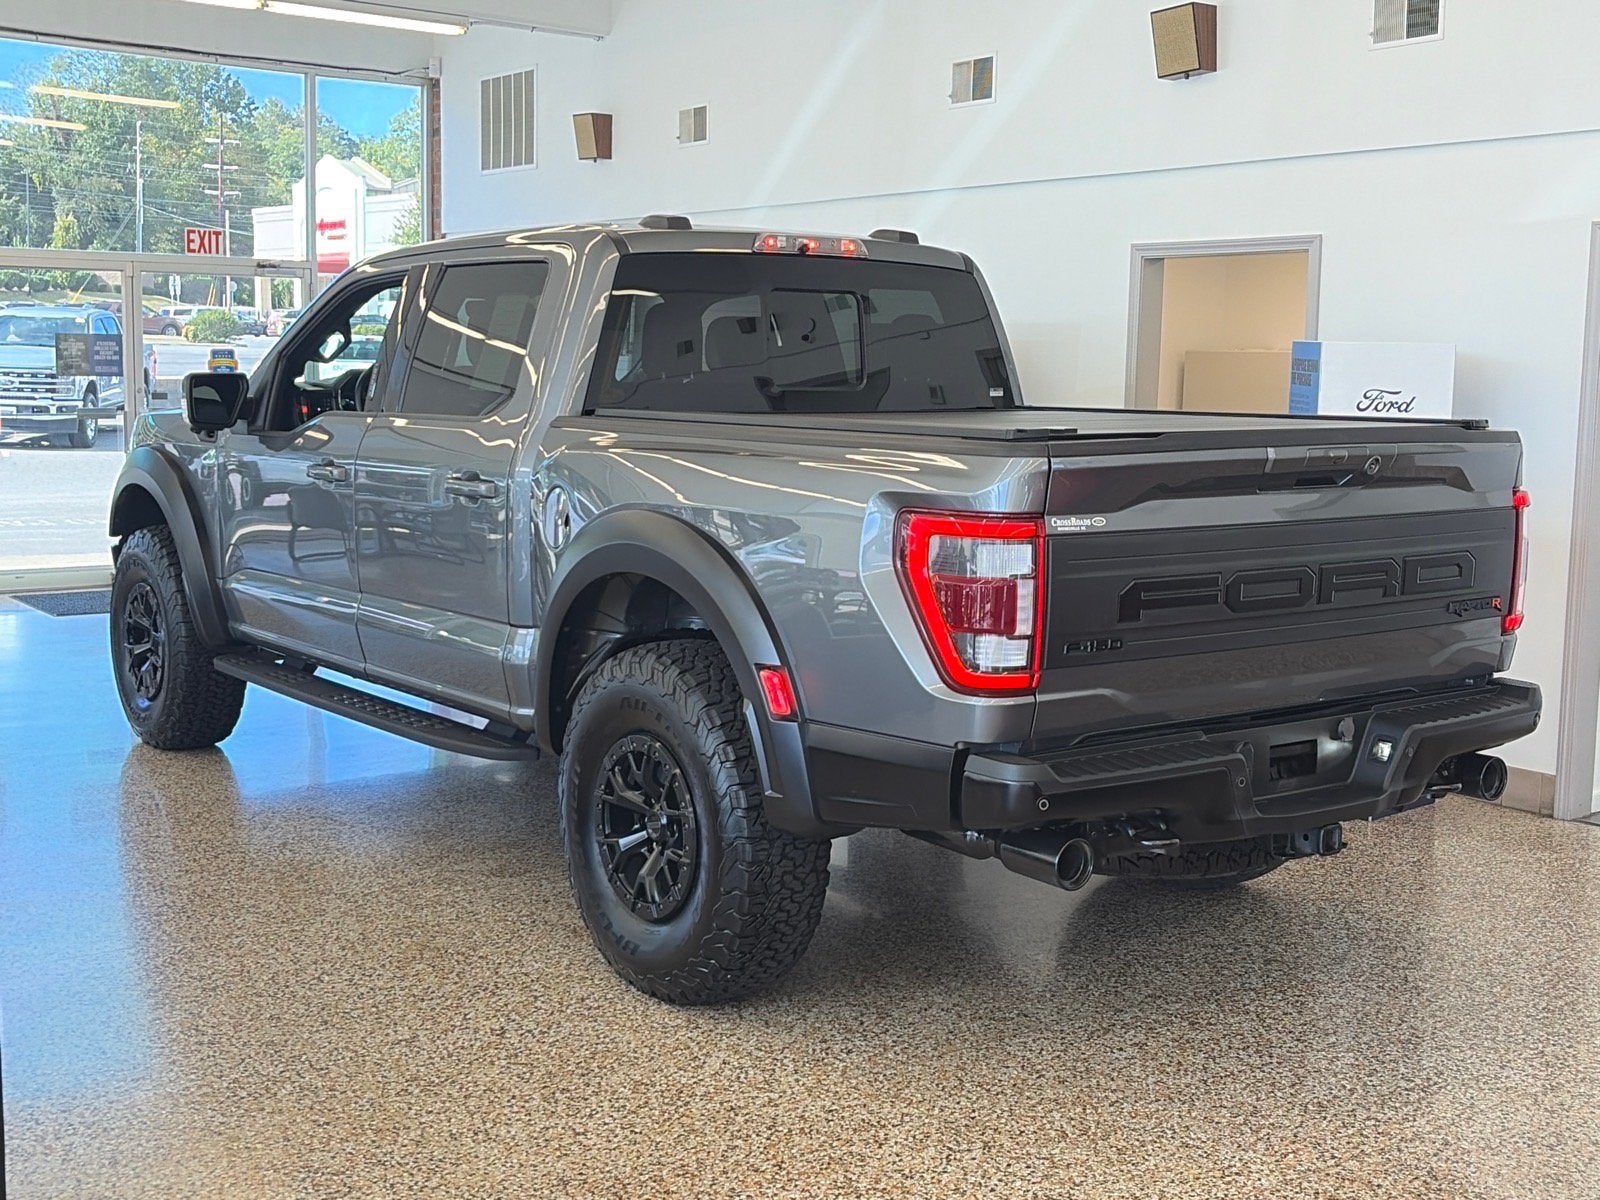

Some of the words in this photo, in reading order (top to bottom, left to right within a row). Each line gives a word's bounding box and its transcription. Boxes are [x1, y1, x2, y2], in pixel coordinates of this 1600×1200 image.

[186, 229, 222, 254] EXIT
[1356, 388, 1416, 413] Ford
[1118, 550, 1476, 624] FORD
